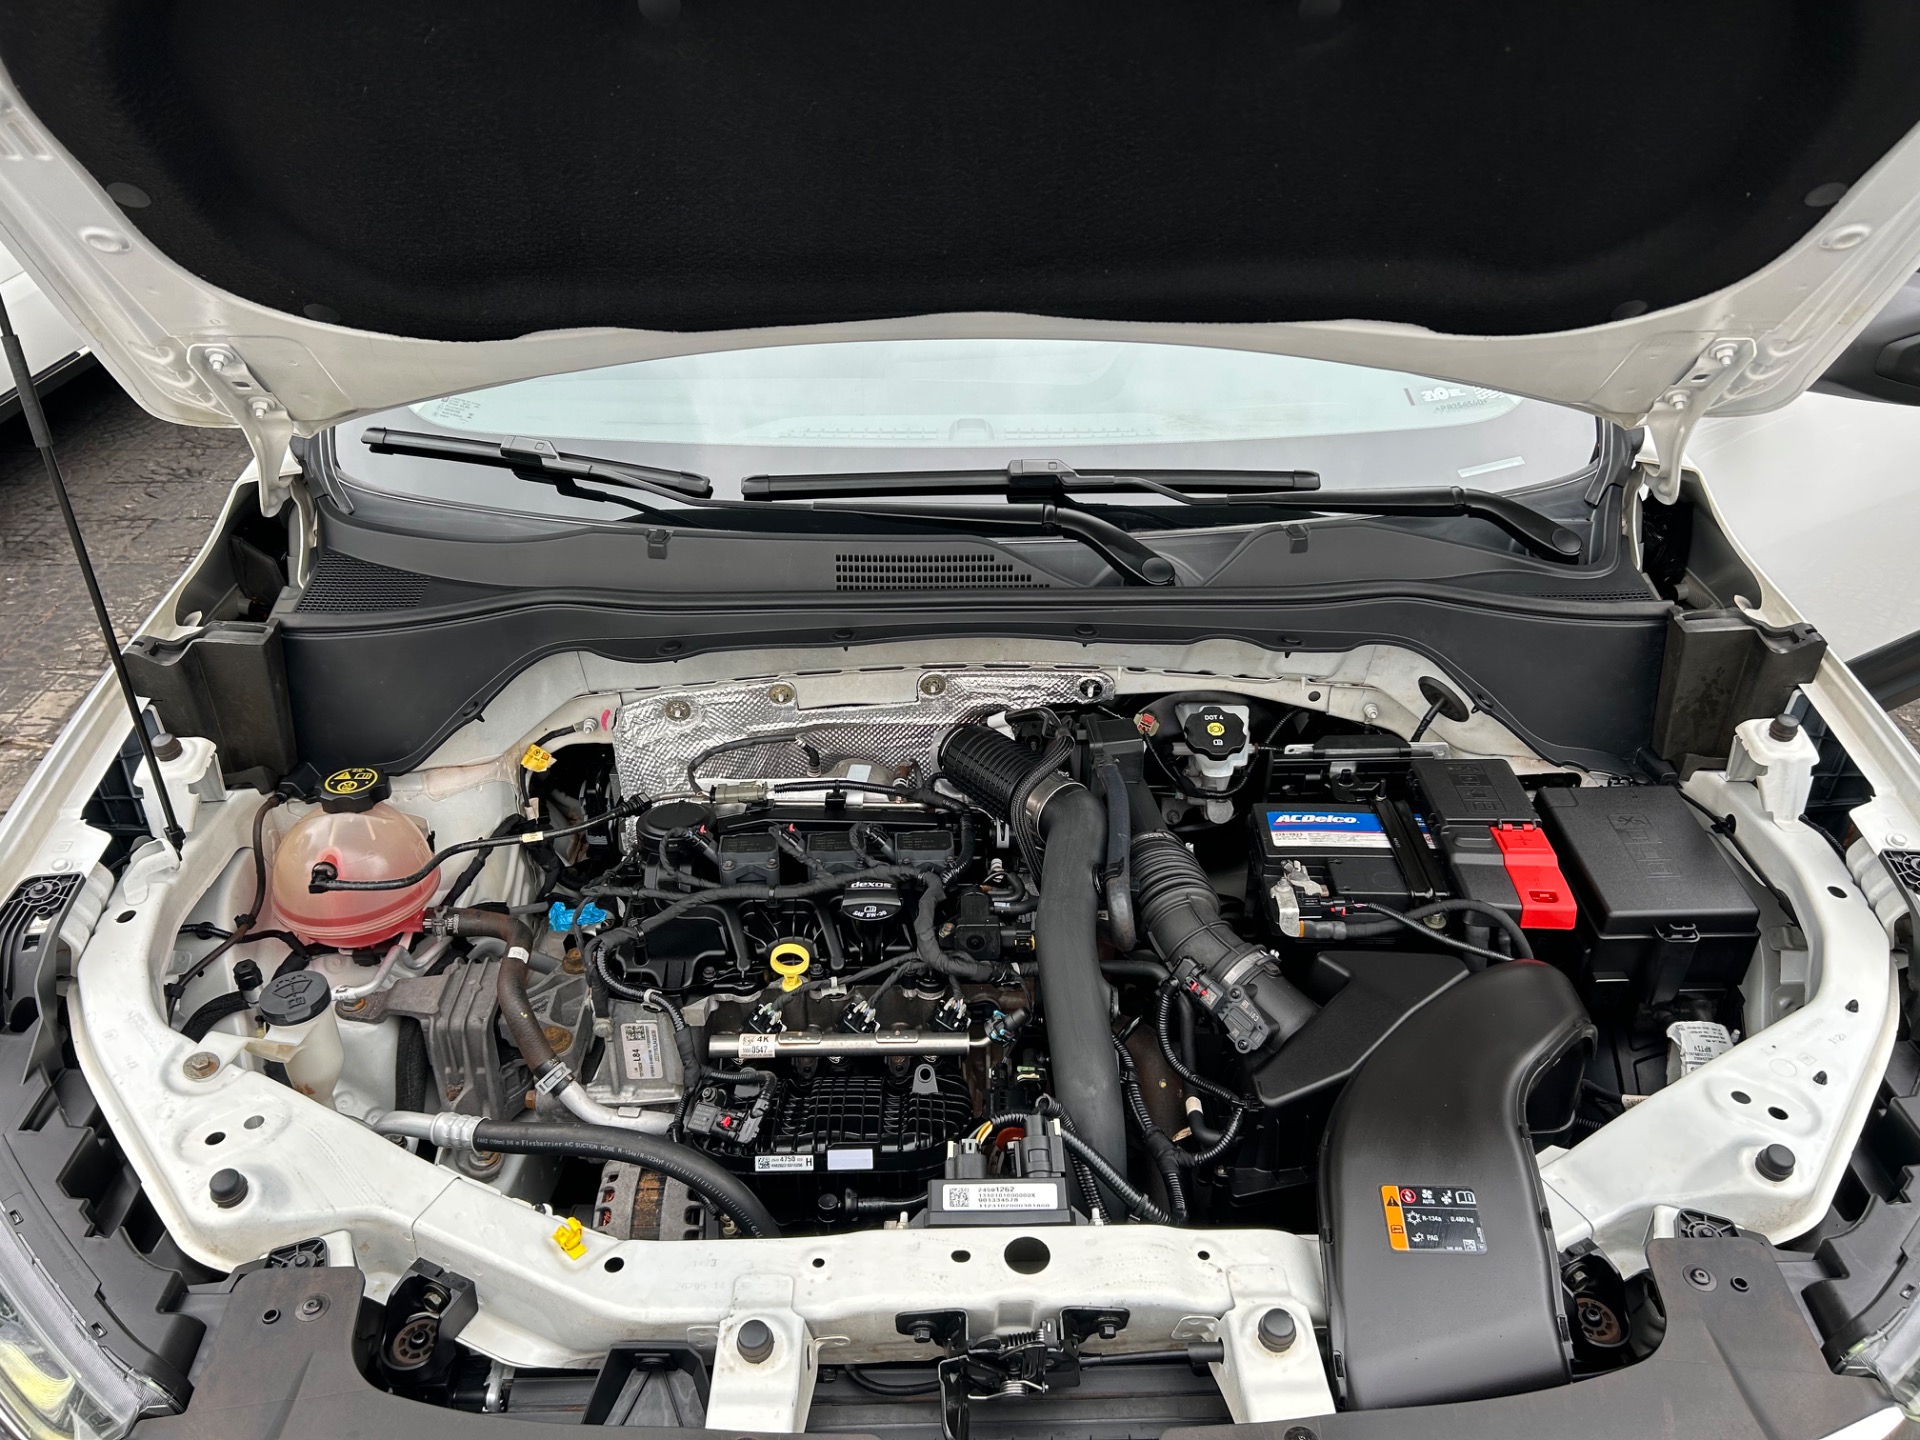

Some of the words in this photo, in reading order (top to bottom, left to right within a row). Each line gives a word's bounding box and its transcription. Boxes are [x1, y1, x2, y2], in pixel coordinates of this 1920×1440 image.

[1275, 814, 1358, 824] ACDelco
[850, 881, 893, 889] dexos
[632, 1048, 641, 1062] L84
[521, 1139, 562, 1147] Flexbarrier
[575, 1142, 598, 1150] SUCTION
[806, 1158, 812, 1166] H
